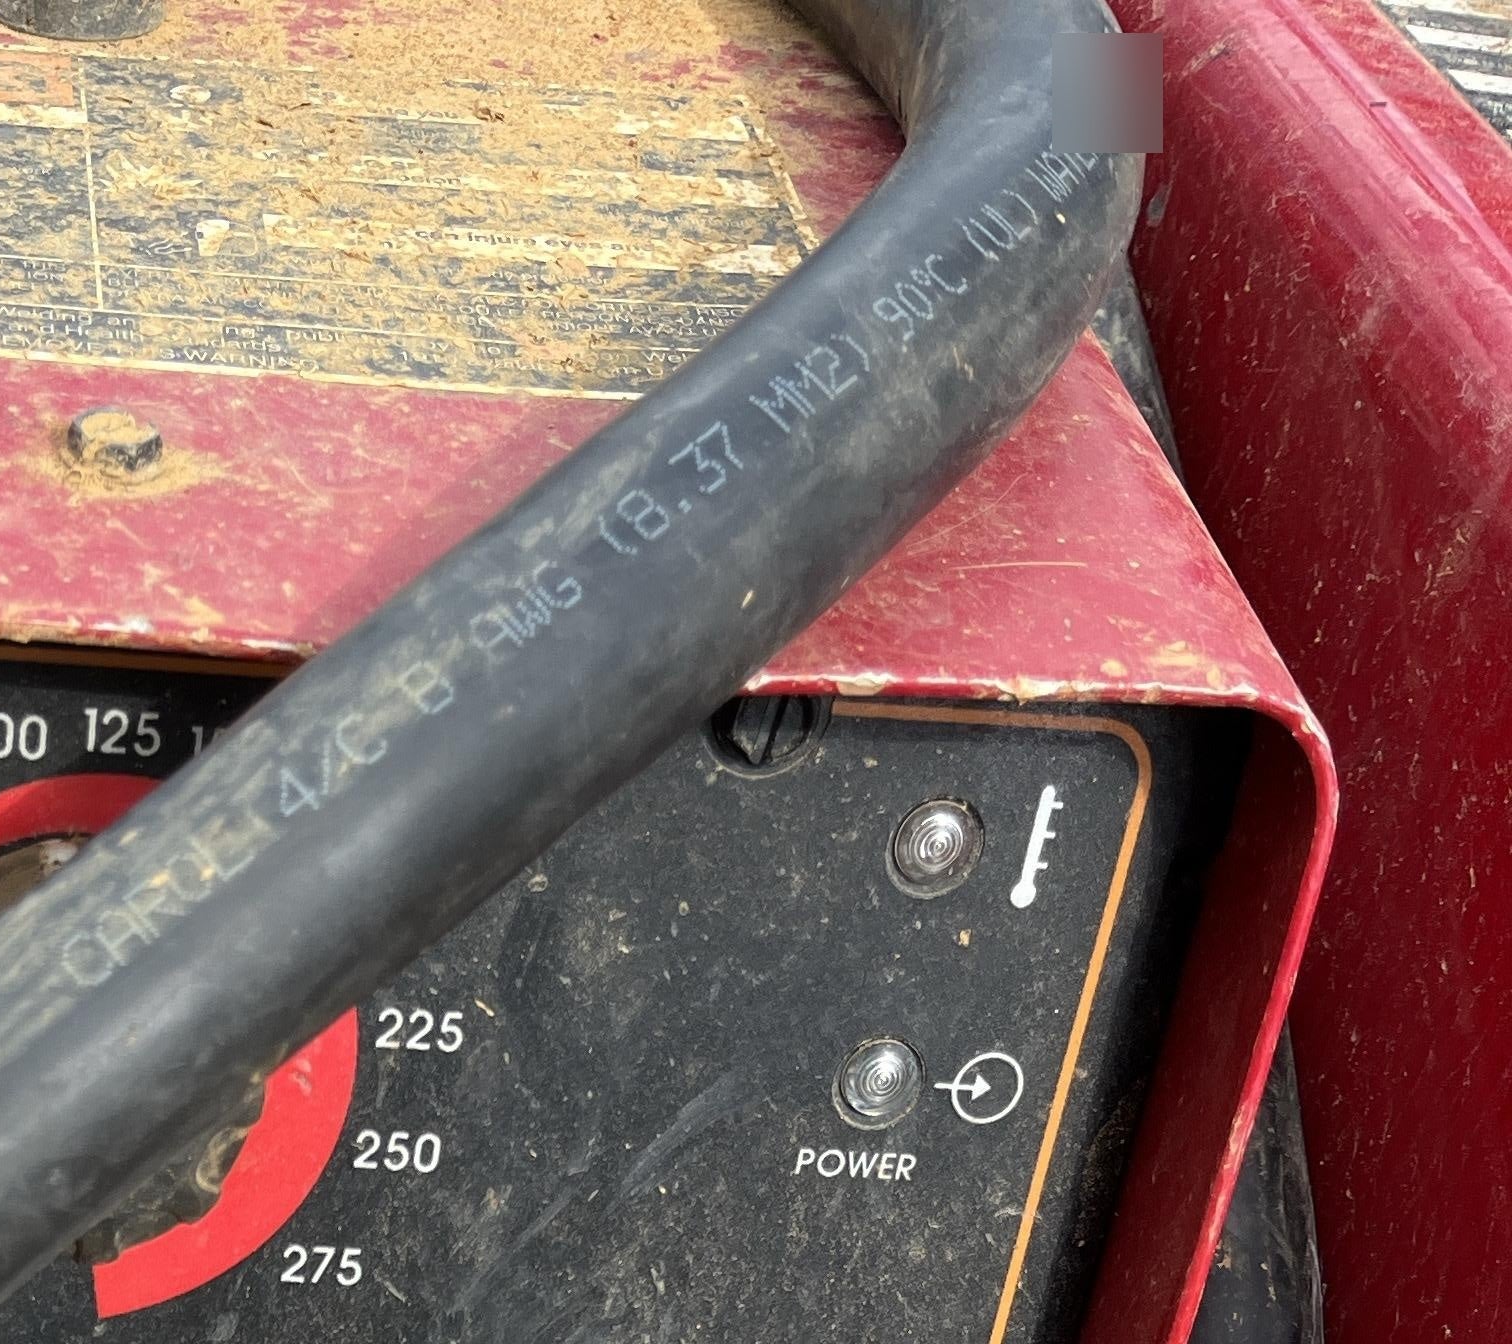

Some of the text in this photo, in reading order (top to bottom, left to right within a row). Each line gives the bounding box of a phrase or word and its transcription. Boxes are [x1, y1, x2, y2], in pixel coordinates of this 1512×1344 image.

[84, 707, 162, 758] 125
[374, 1008, 465, 1053] 225
[352, 1129, 443, 1174] 250
[793, 1148, 918, 1182] POWER
[280, 1245, 363, 1287] 275
